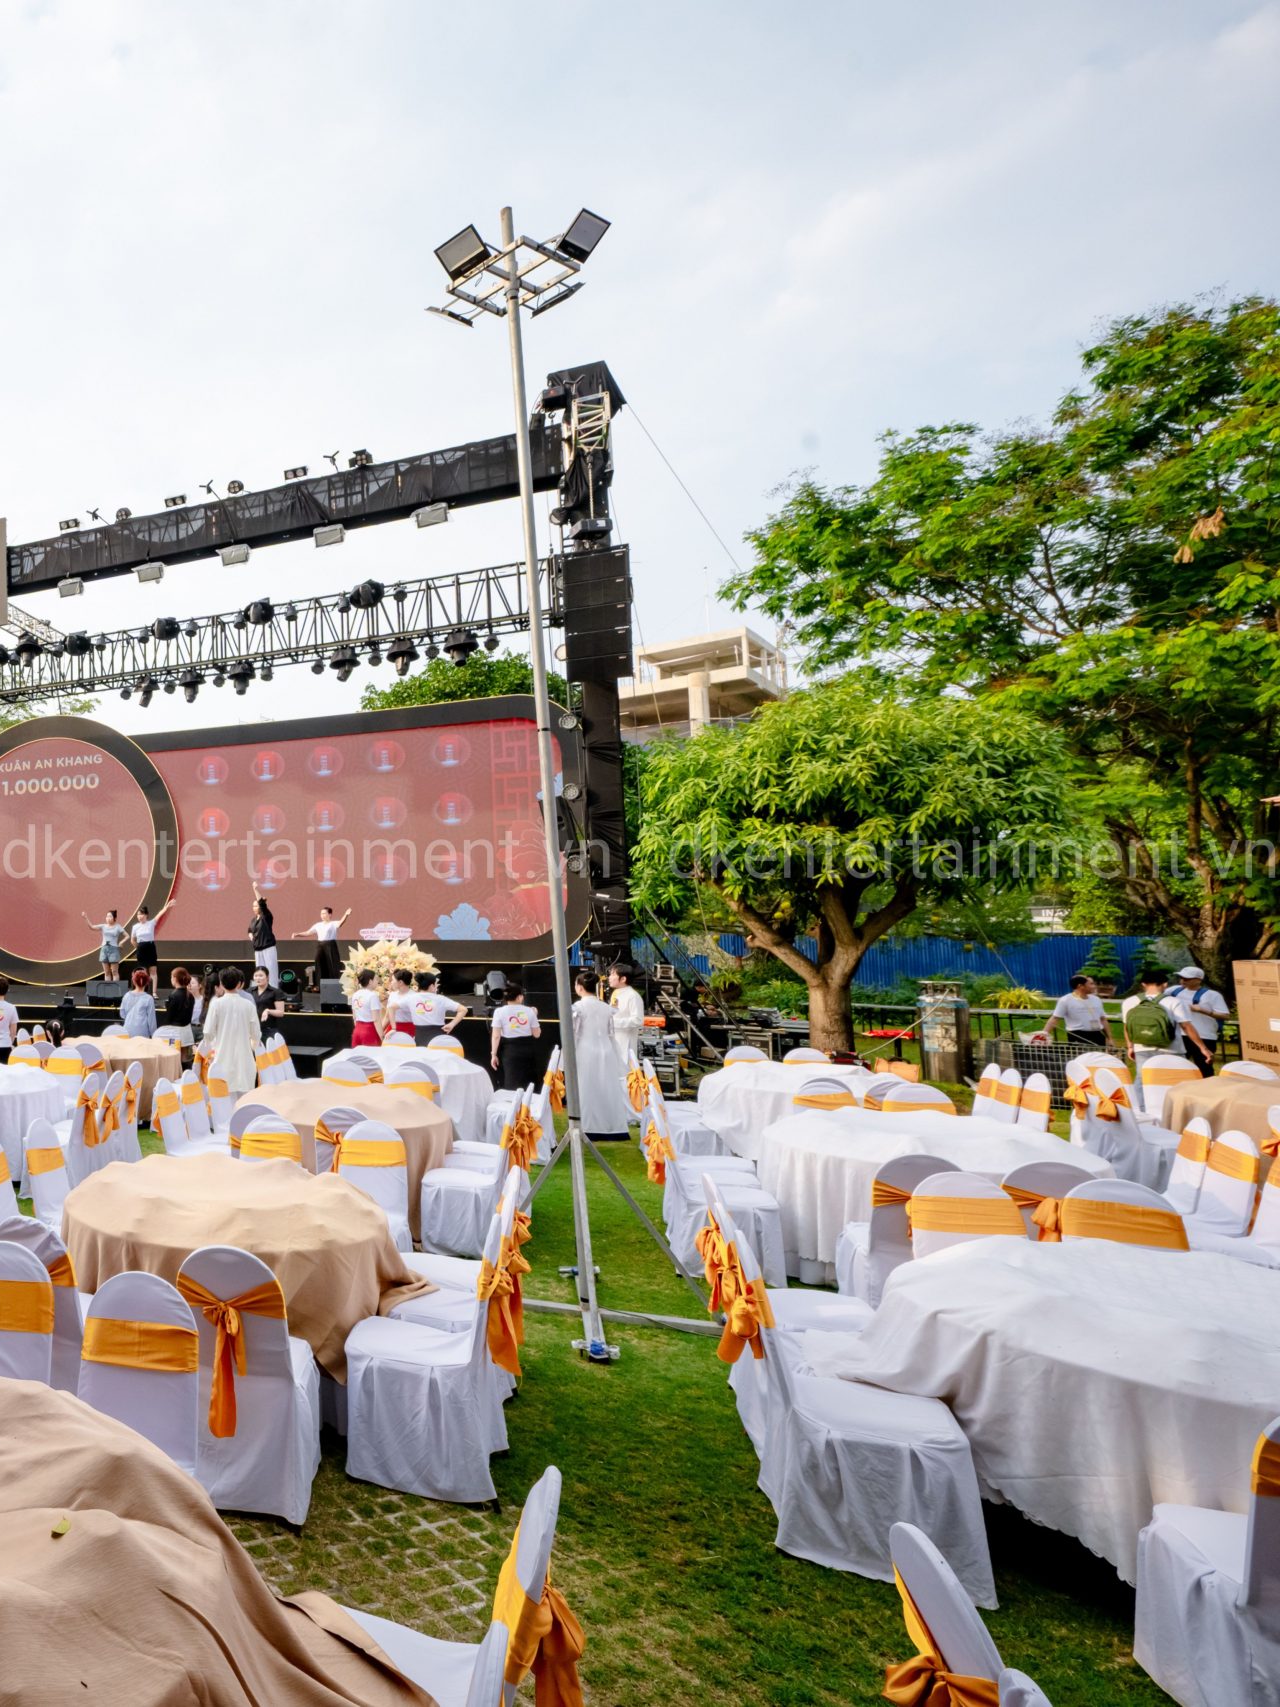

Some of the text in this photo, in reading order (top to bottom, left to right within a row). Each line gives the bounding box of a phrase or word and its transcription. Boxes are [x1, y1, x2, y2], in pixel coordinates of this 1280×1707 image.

[35, 759, 53, 769] AN
[56, 754, 103, 768] KHANG
[2, 773, 100, 796] 1.000.000
[1246, 1041, 1279, 1054] TOSHIBA
